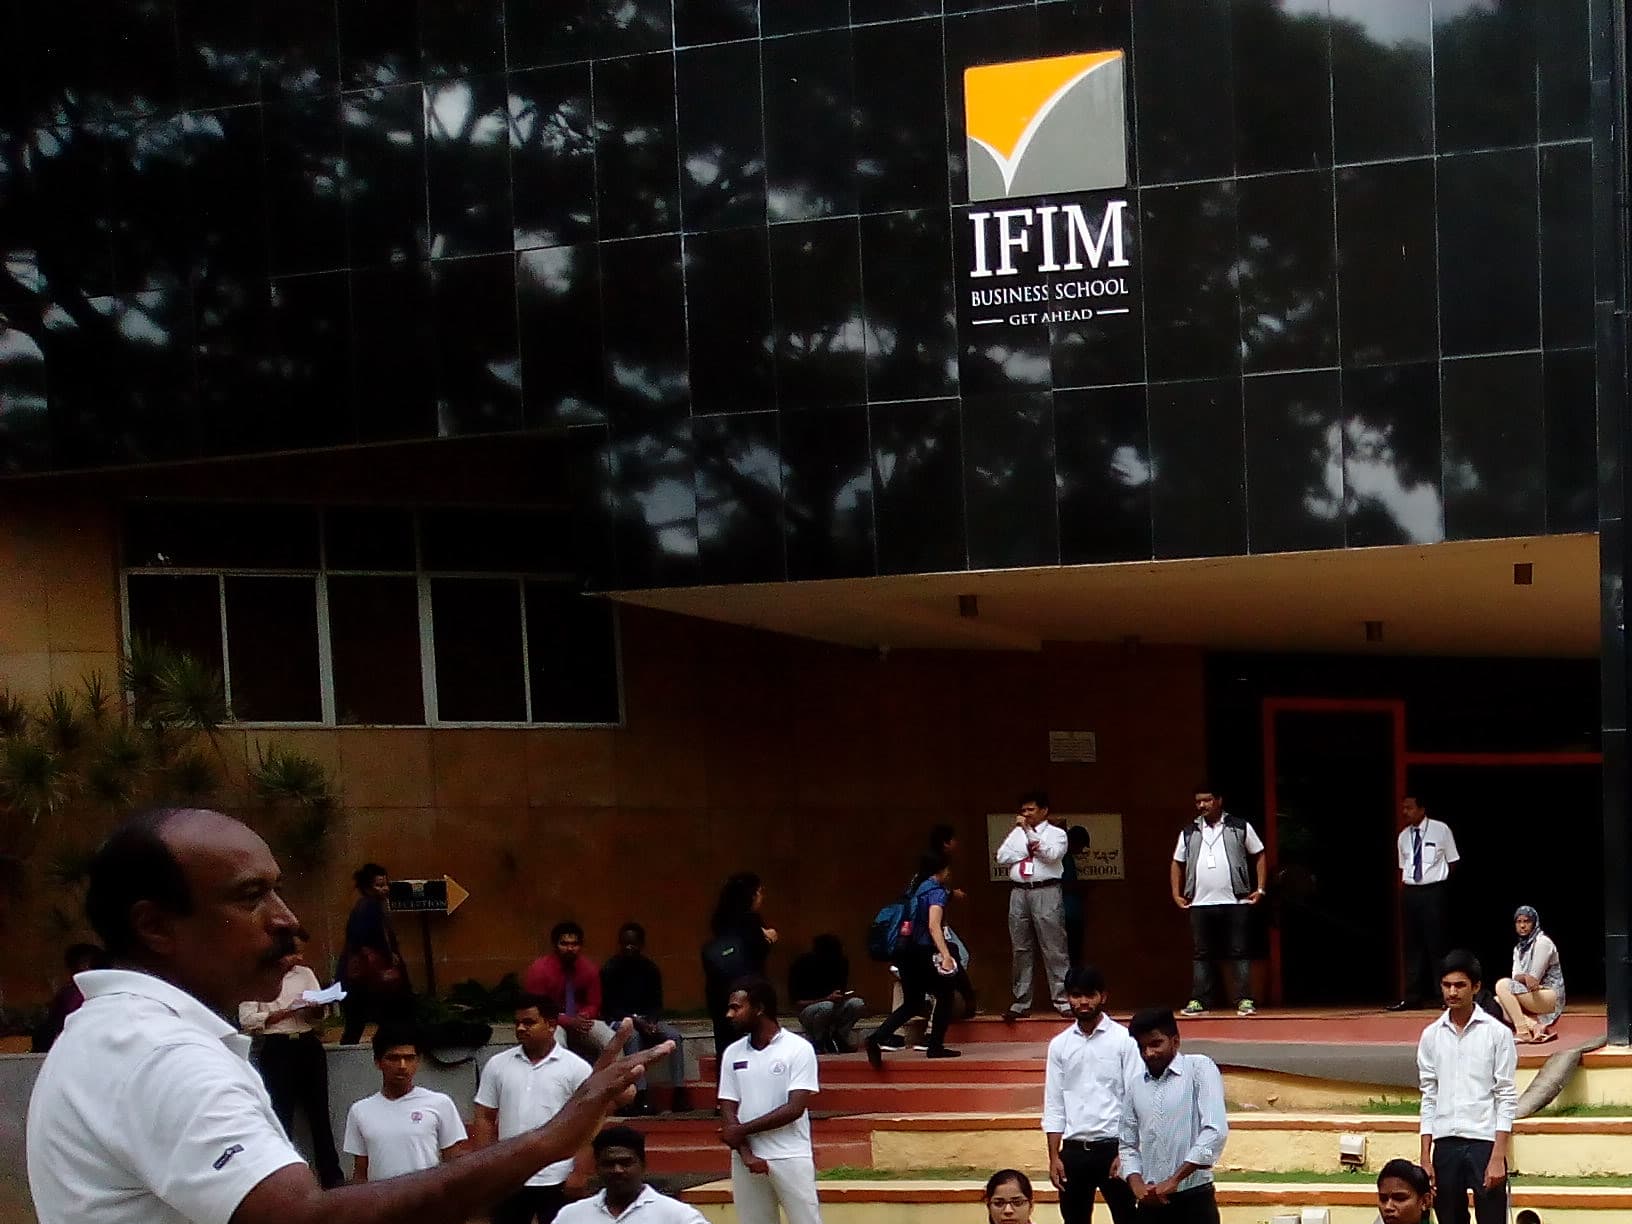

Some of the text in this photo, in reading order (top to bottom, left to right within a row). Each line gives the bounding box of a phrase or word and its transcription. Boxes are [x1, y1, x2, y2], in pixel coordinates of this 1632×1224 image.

[968, 200, 1130, 279] IFIM
[971, 278, 1129, 308] BUSINESS SCHOOL
[1008, 308, 1093, 326] GET AHEAD
